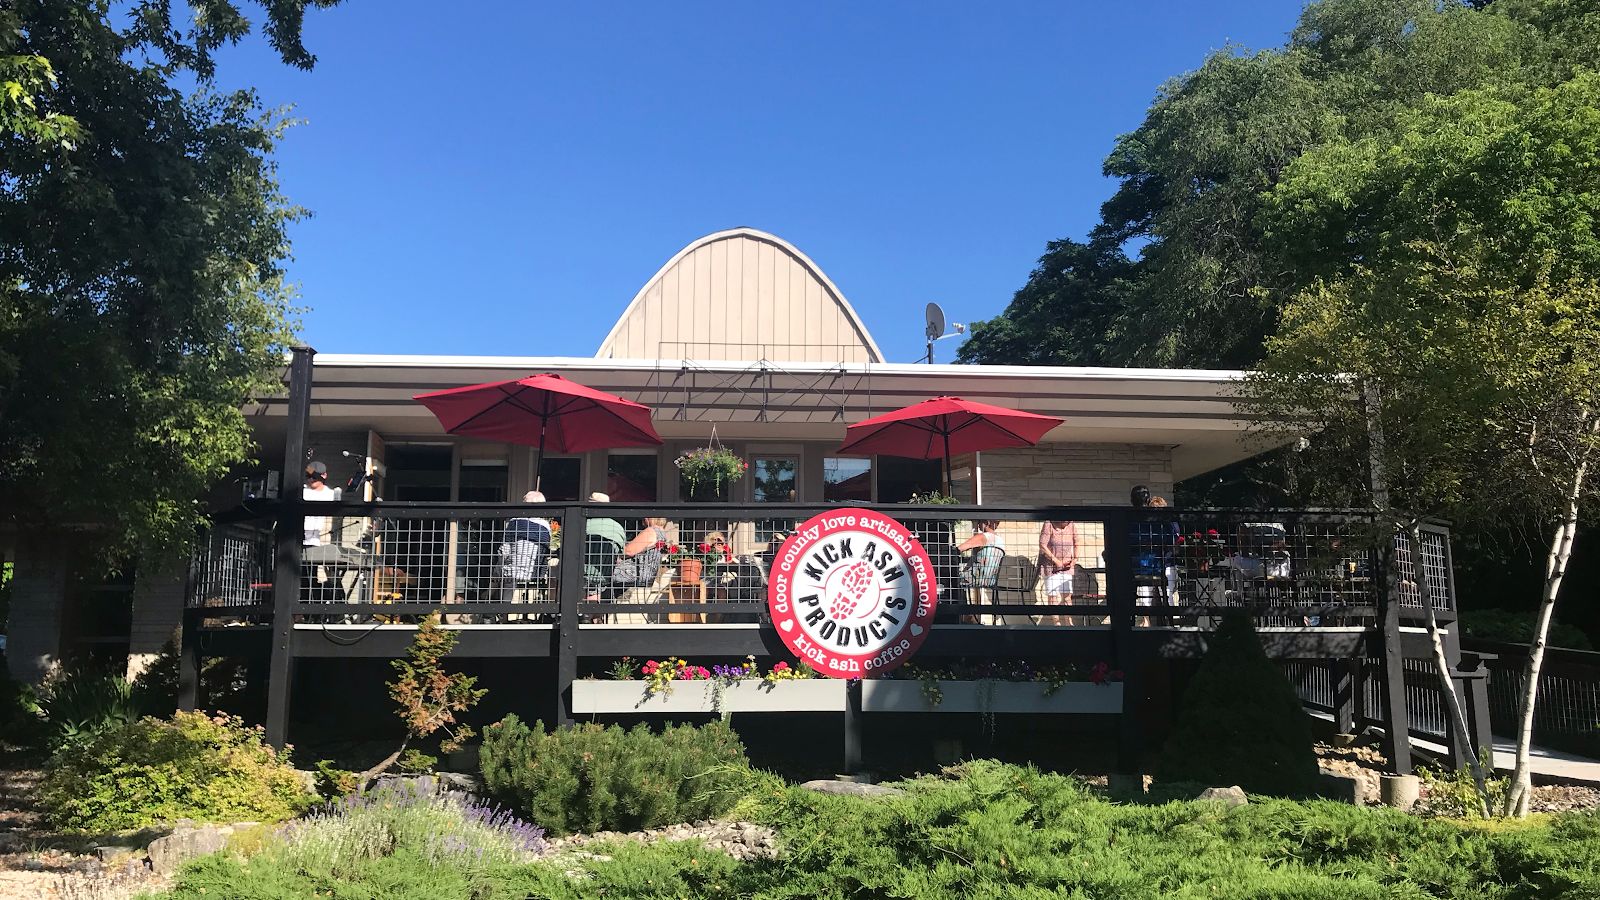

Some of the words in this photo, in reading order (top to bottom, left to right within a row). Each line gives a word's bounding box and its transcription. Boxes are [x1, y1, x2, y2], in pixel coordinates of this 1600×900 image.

[821, 515, 856, 531] love
[859, 516, 913, 555] artisan
[780, 524, 820, 572] county
[803, 537, 853, 582] KICK
[859, 541, 905, 584] ASH
[775, 574, 788, 613] door
[908, 555, 931, 618] granola
[798, 594, 907, 648] PRODUCTS
[793, 634, 827, 665] kick
[828, 658, 860, 672] ash
[864, 638, 910, 671] coffee
